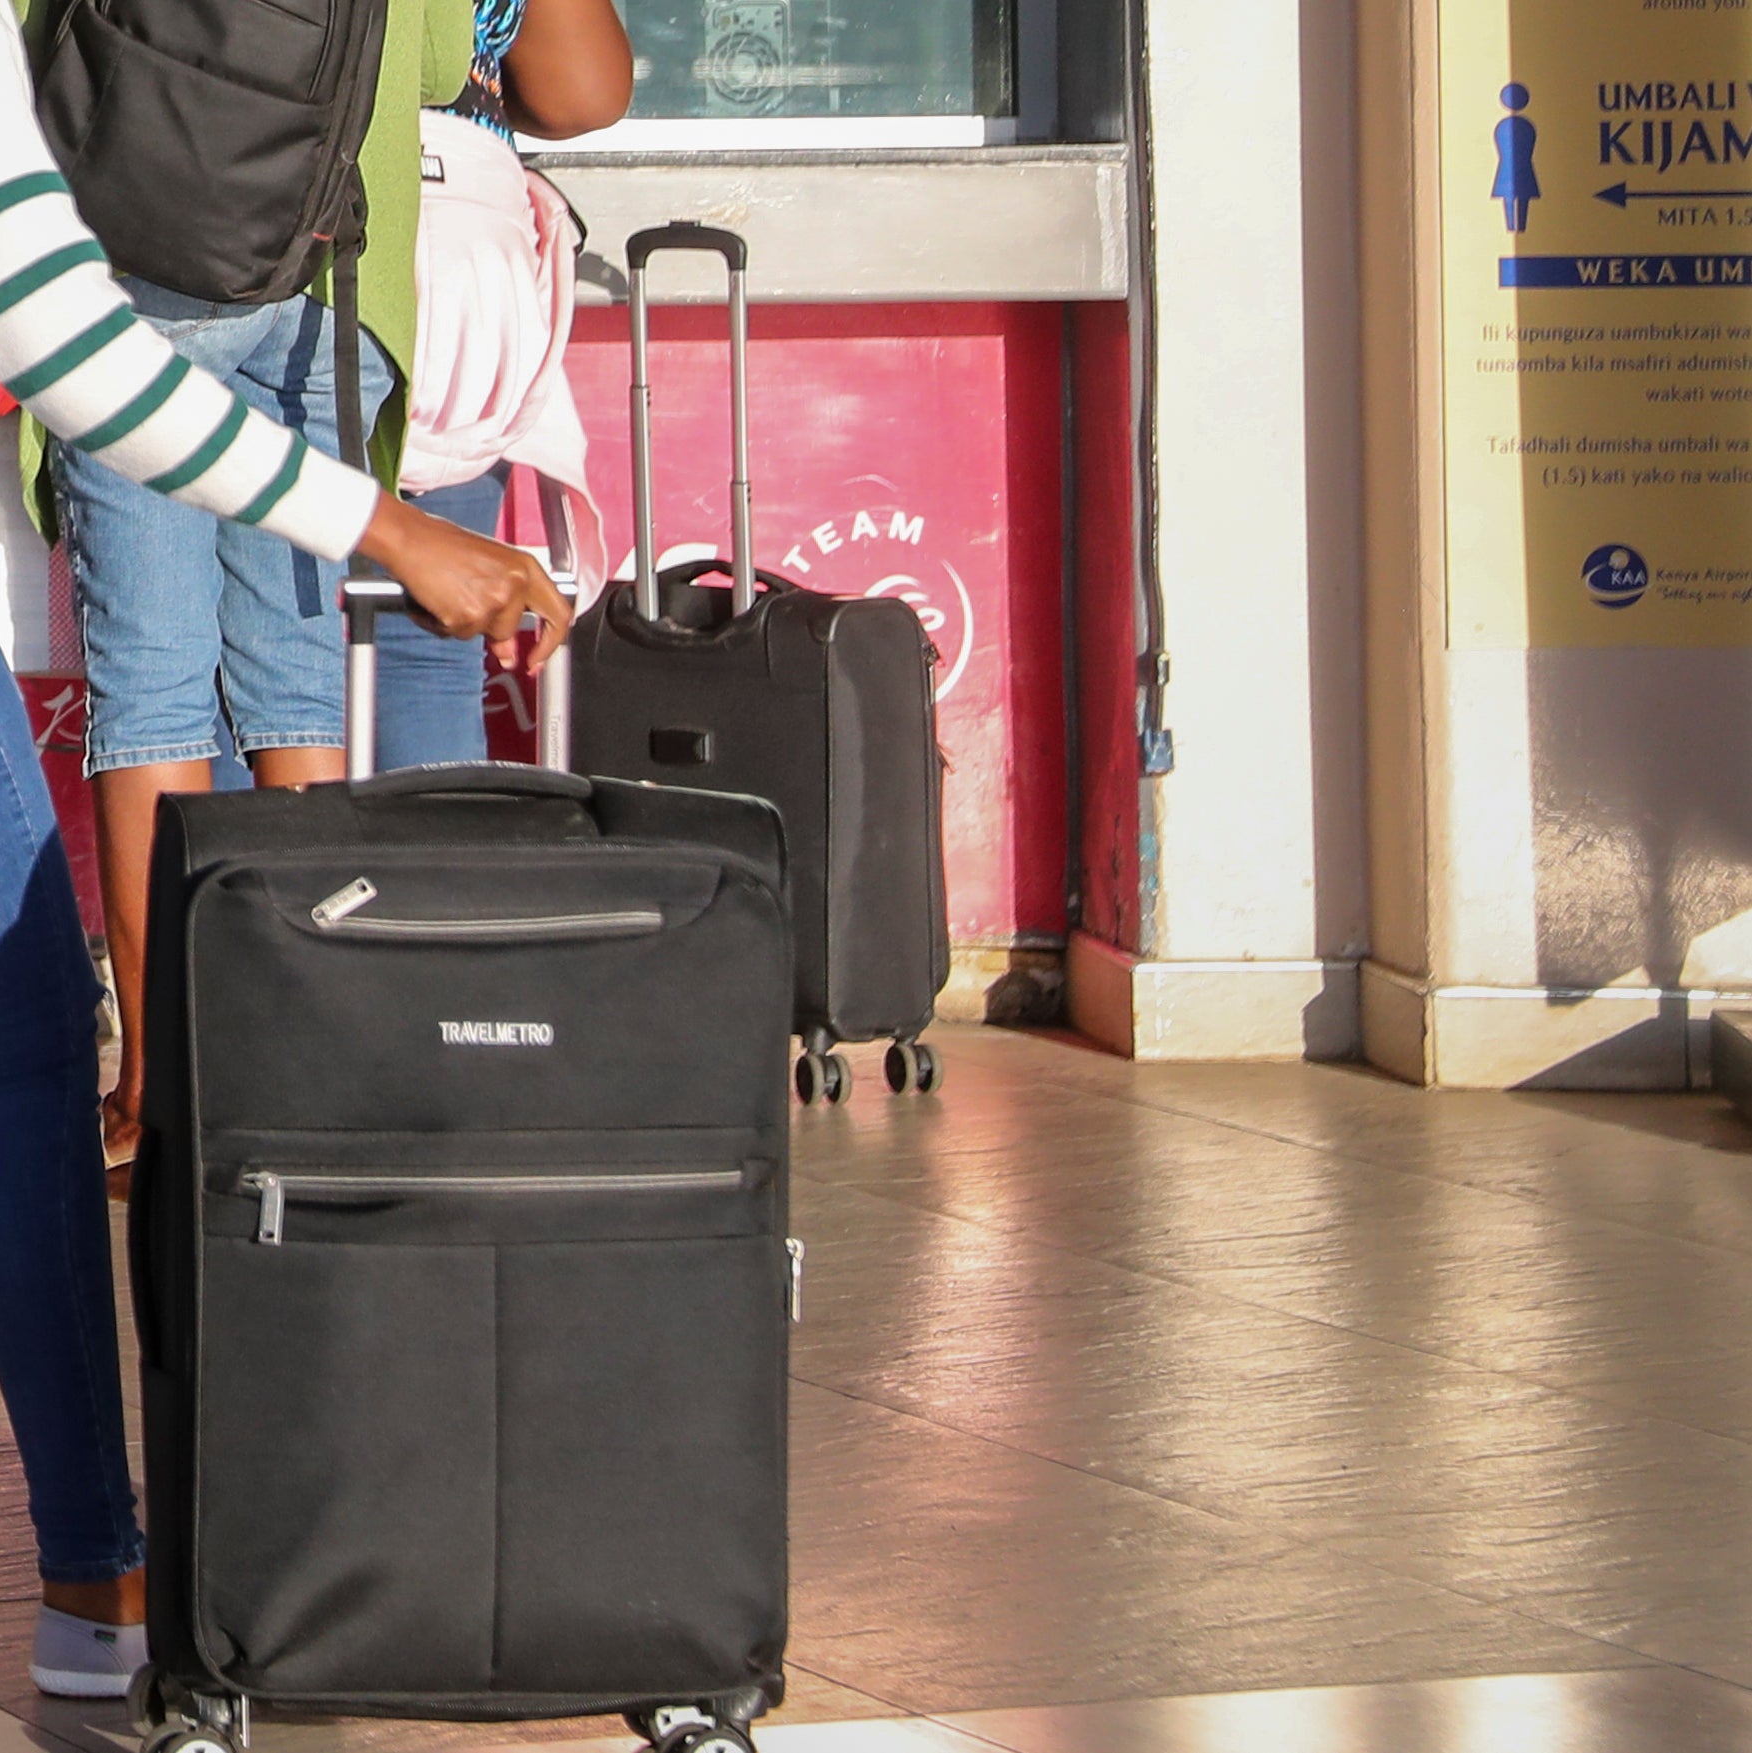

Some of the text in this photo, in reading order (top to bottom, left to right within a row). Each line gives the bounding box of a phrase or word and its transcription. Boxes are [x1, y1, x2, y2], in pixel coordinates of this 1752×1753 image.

[1599, 81, 1735, 111] UMBALI
[1658, 206, 1718, 226] MITA
[1576, 258, 1752, 284] WEKA UM
[1506, 324, 1604, 344] kupunguza
[1728, 326, 1751, 340] wa
[1476, 356, 1565, 373] tunaomba
[1572, 354, 1604, 372] kila
[1610, 354, 1669, 372] msafiri
[1647, 385, 1704, 403] wakati
[1487, 436, 1749, 455] Tafadhali dumisha umbali wa
[1543, 467, 1586, 488] (1.5)
[1592, 466, 1625, 483] kati
[1632, 468, 1674, 487] yako
[1681, 469, 1701, 484] na
[782, 510, 925, 573] TEAM
[1611, 570, 1646, 586] KAA
[439, 1021, 554, 1045] TRAVELMETRO
